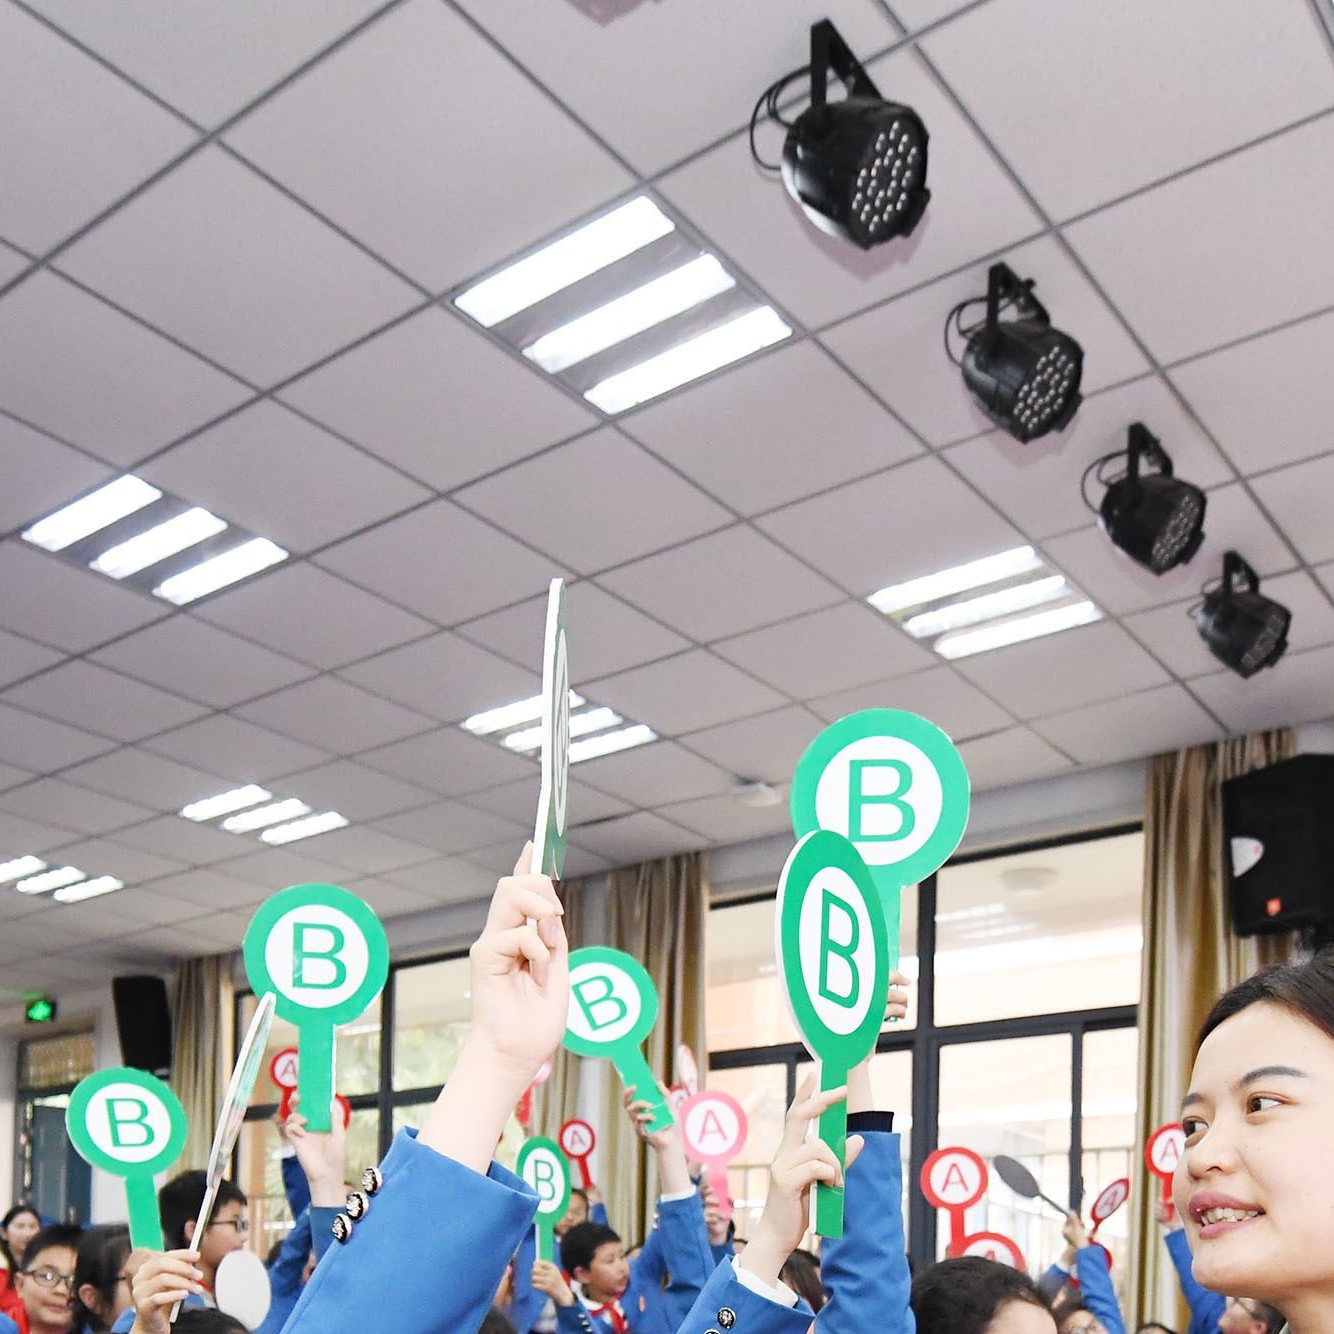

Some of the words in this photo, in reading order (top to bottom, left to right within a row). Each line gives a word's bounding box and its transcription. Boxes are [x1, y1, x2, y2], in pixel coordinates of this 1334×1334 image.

[848, 758, 916, 843] B
[291, 922, 347, 990] B
[818, 888, 860, 1009] B
[572, 975, 628, 1031] B
[280, 1059, 298, 1079] A
[106, 1098, 155, 1147] B
[570, 1129, 587, 1149] A
[698, 1109, 728, 1144] A
[1160, 1137, 1180, 1163] A
[534, 1159, 556, 1201] B
[941, 1163, 969, 1193] A
[1101, 1189, 1118, 1210] A
